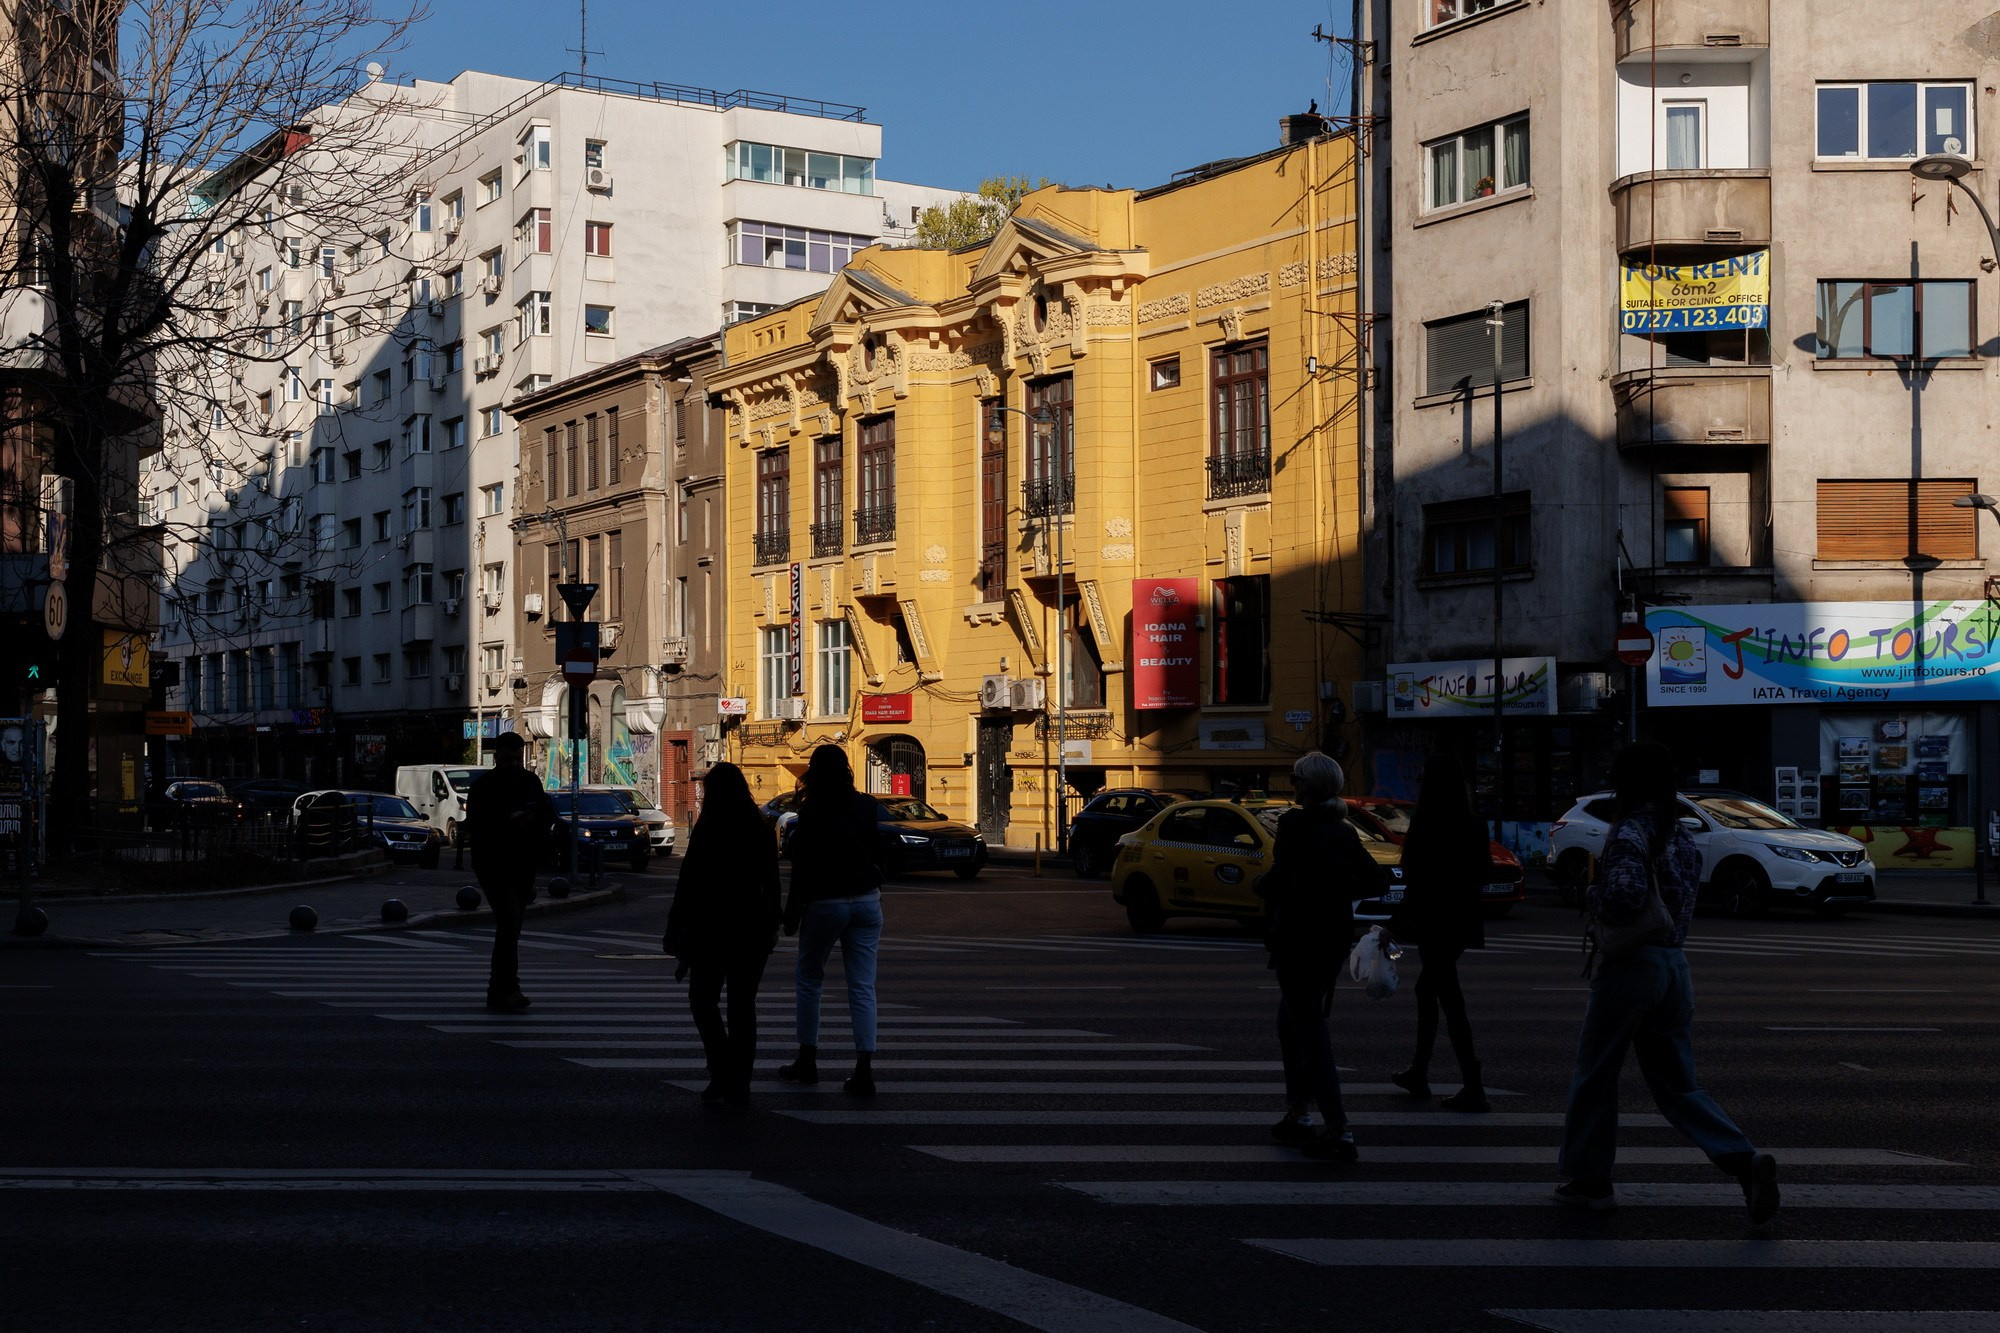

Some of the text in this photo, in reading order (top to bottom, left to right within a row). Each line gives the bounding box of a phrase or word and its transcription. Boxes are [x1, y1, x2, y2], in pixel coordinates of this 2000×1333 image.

[1626, 252, 1765, 282] FOR RENT
[1671, 281, 1717, 297] 66m2
[1666, 298, 1686, 307] FOR
[1688, 296, 1725, 306] CLINIC,
[1728, 294, 1763, 304] OFFICE
[1623, 306, 1763, 330] 0727.123.403
[791, 564, 800, 616] SEX
[49, 594, 63, 627] 60
[1144, 622, 1187, 632] IOANA
[1149, 634, 1183, 643] HAIR
[1163, 645, 1170, 654] &
[1722, 622, 1986, 680] J'INFO TOURS
[1139, 657, 1192, 667] BEAUTY
[1861, 664, 1986, 680] www.jinfotours.ro
[1420, 674, 1476, 707] J'INFO
[1660, 685, 1707, 694] SINCE 1990
[1753, 686, 1891, 701] IATA Travel Agency
